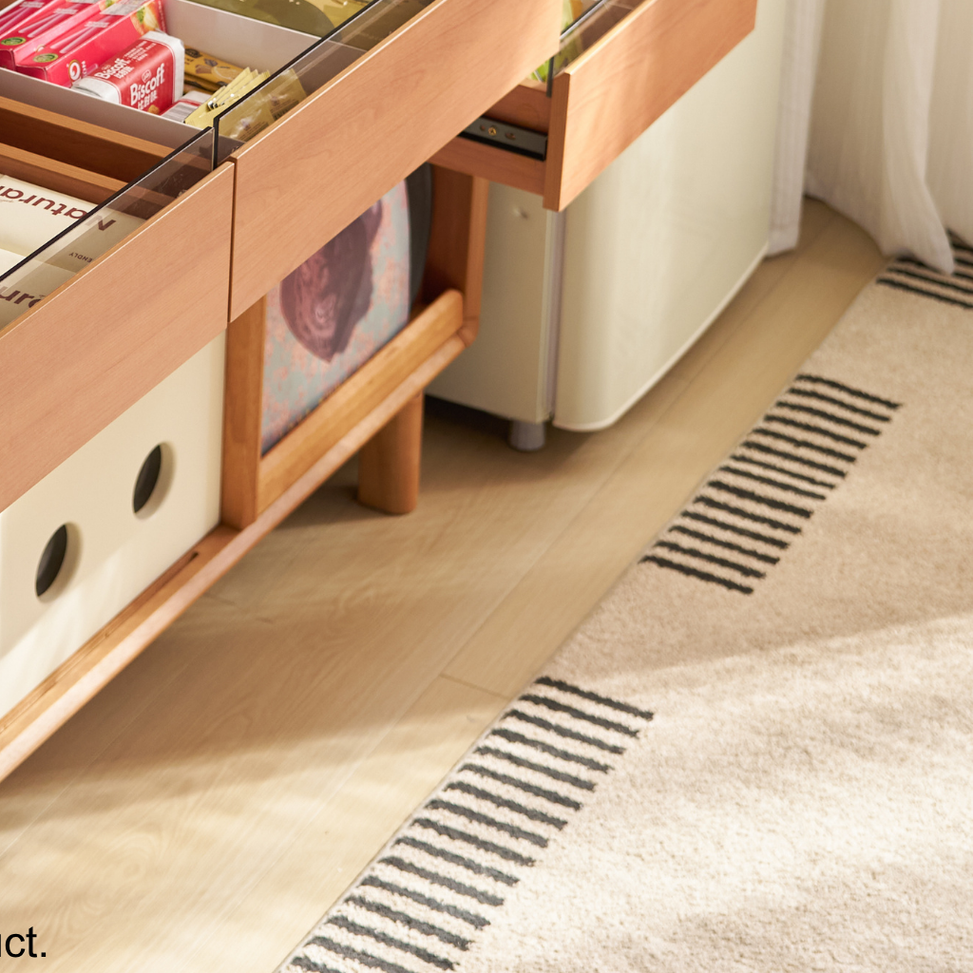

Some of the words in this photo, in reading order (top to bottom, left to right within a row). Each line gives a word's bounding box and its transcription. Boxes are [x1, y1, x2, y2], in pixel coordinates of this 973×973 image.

[94, 58, 132, 79] Biscoff
[130, 62, 165, 106] Biscoff
[69, 252, 95, 263] ENDLY
